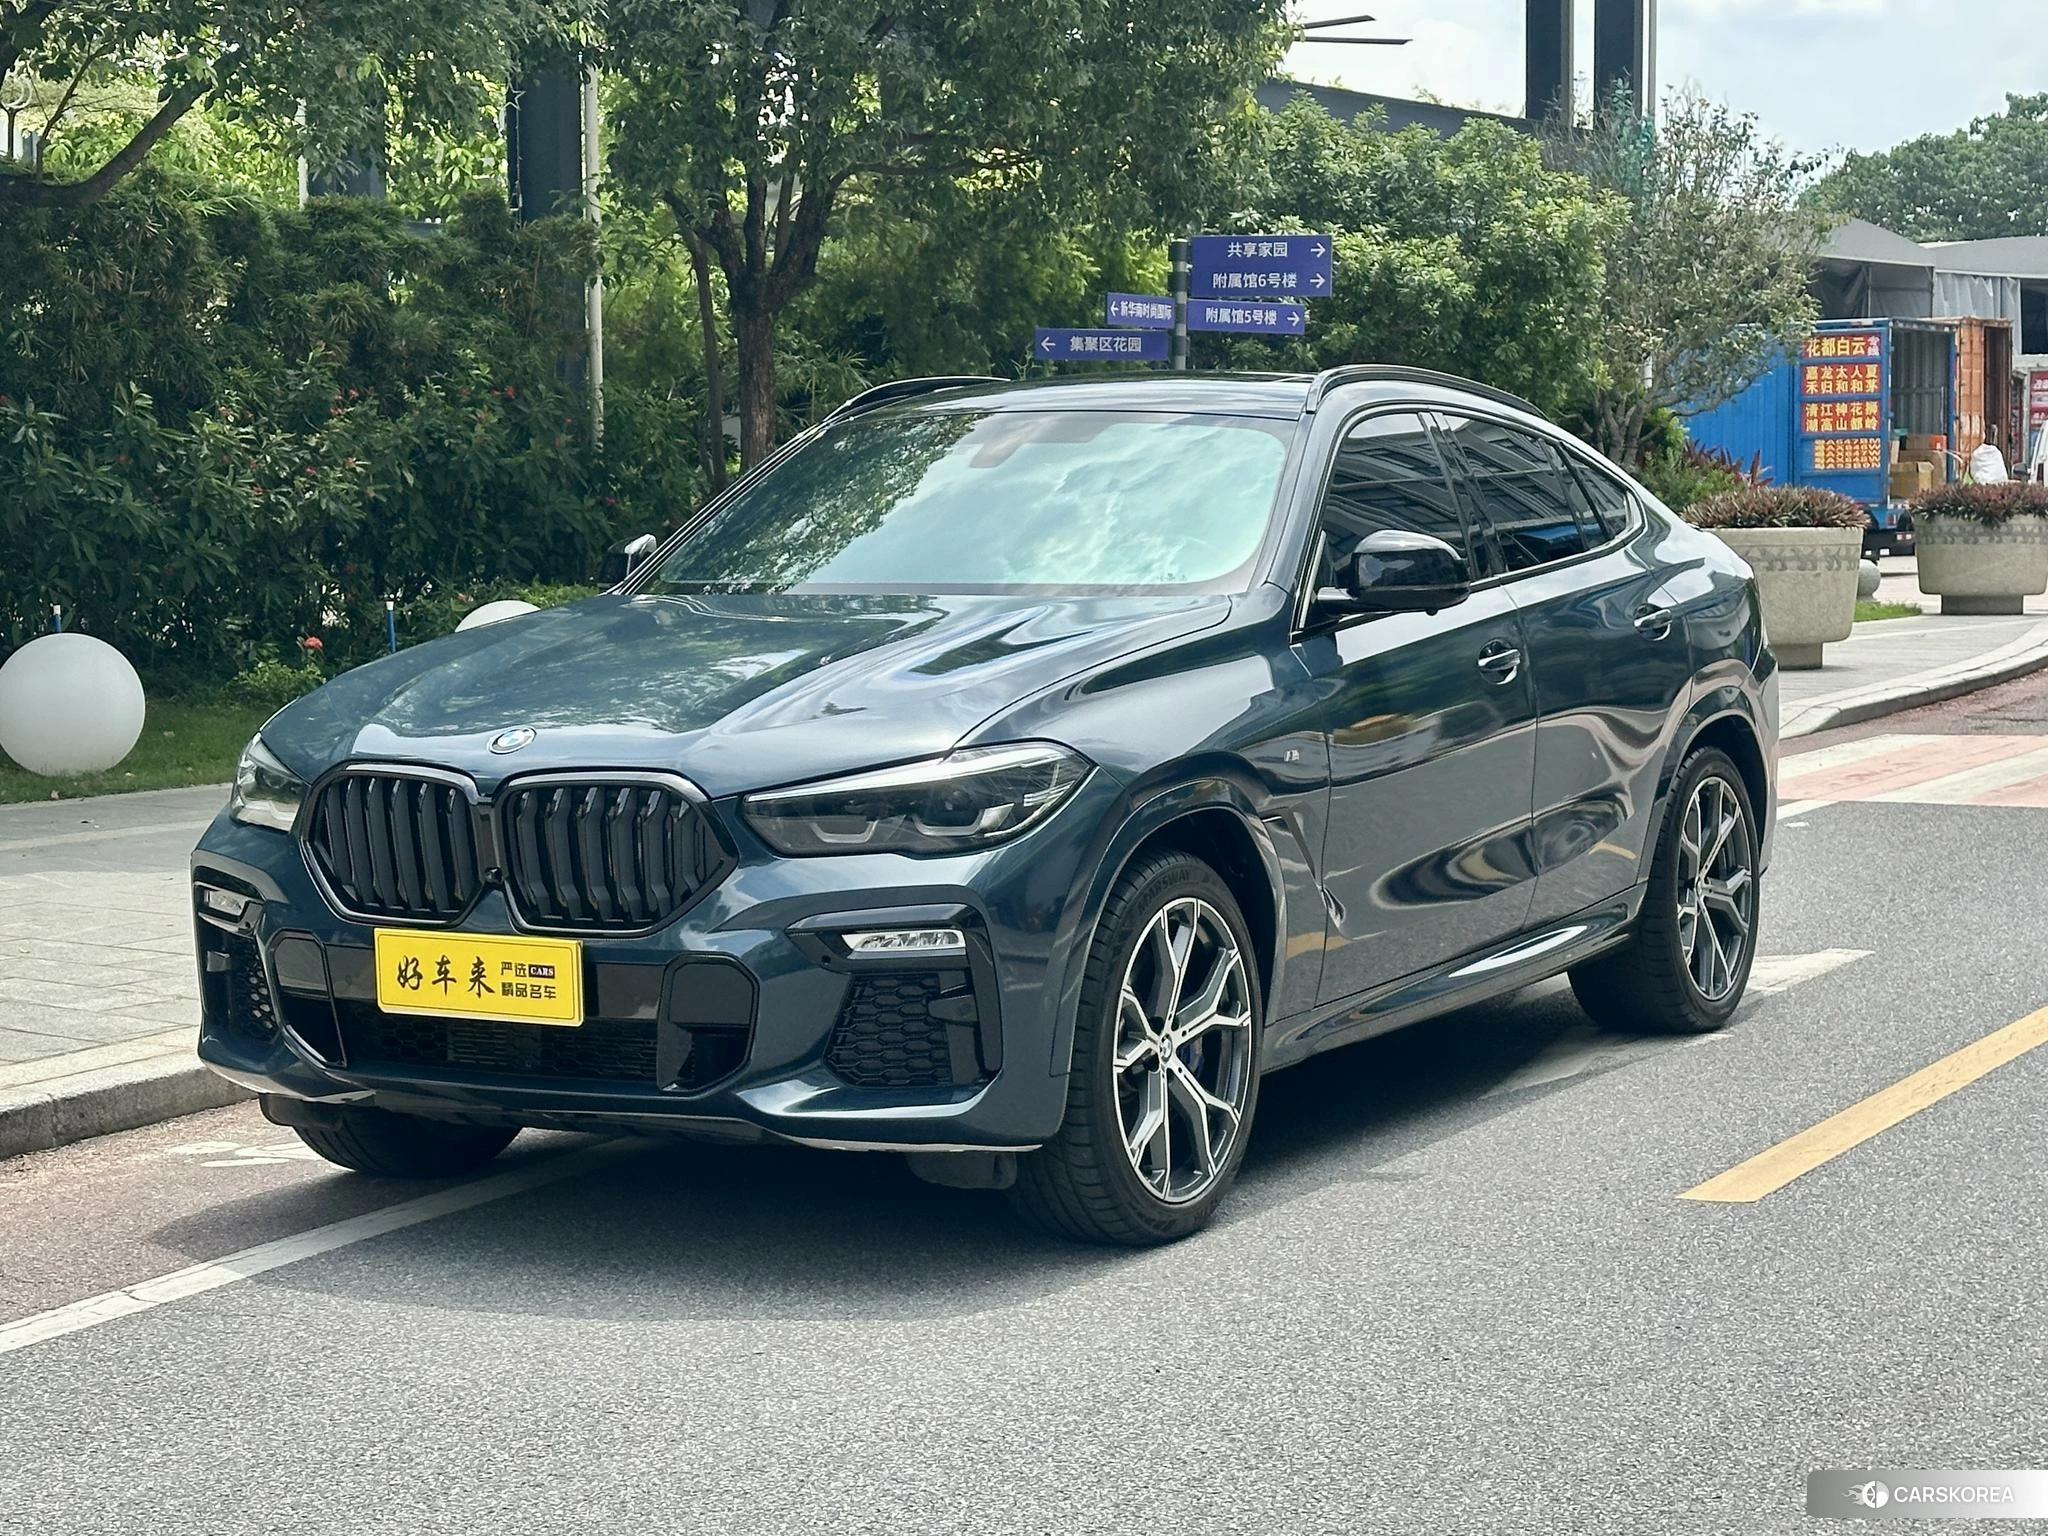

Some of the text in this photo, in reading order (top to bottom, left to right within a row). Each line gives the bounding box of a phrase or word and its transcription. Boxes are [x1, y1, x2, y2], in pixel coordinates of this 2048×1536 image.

[1227, 242, 1288, 258] 共享家园
[1212, 272, 1297, 289] 附属馆6号楼
[1205, 307, 1277, 325] 附属馆5号楼
[1070, 335, 1142, 353] 集聚区花园
[396, 954, 495, 998] 好车来
[501, 961, 554, 977] 严选 CARS
